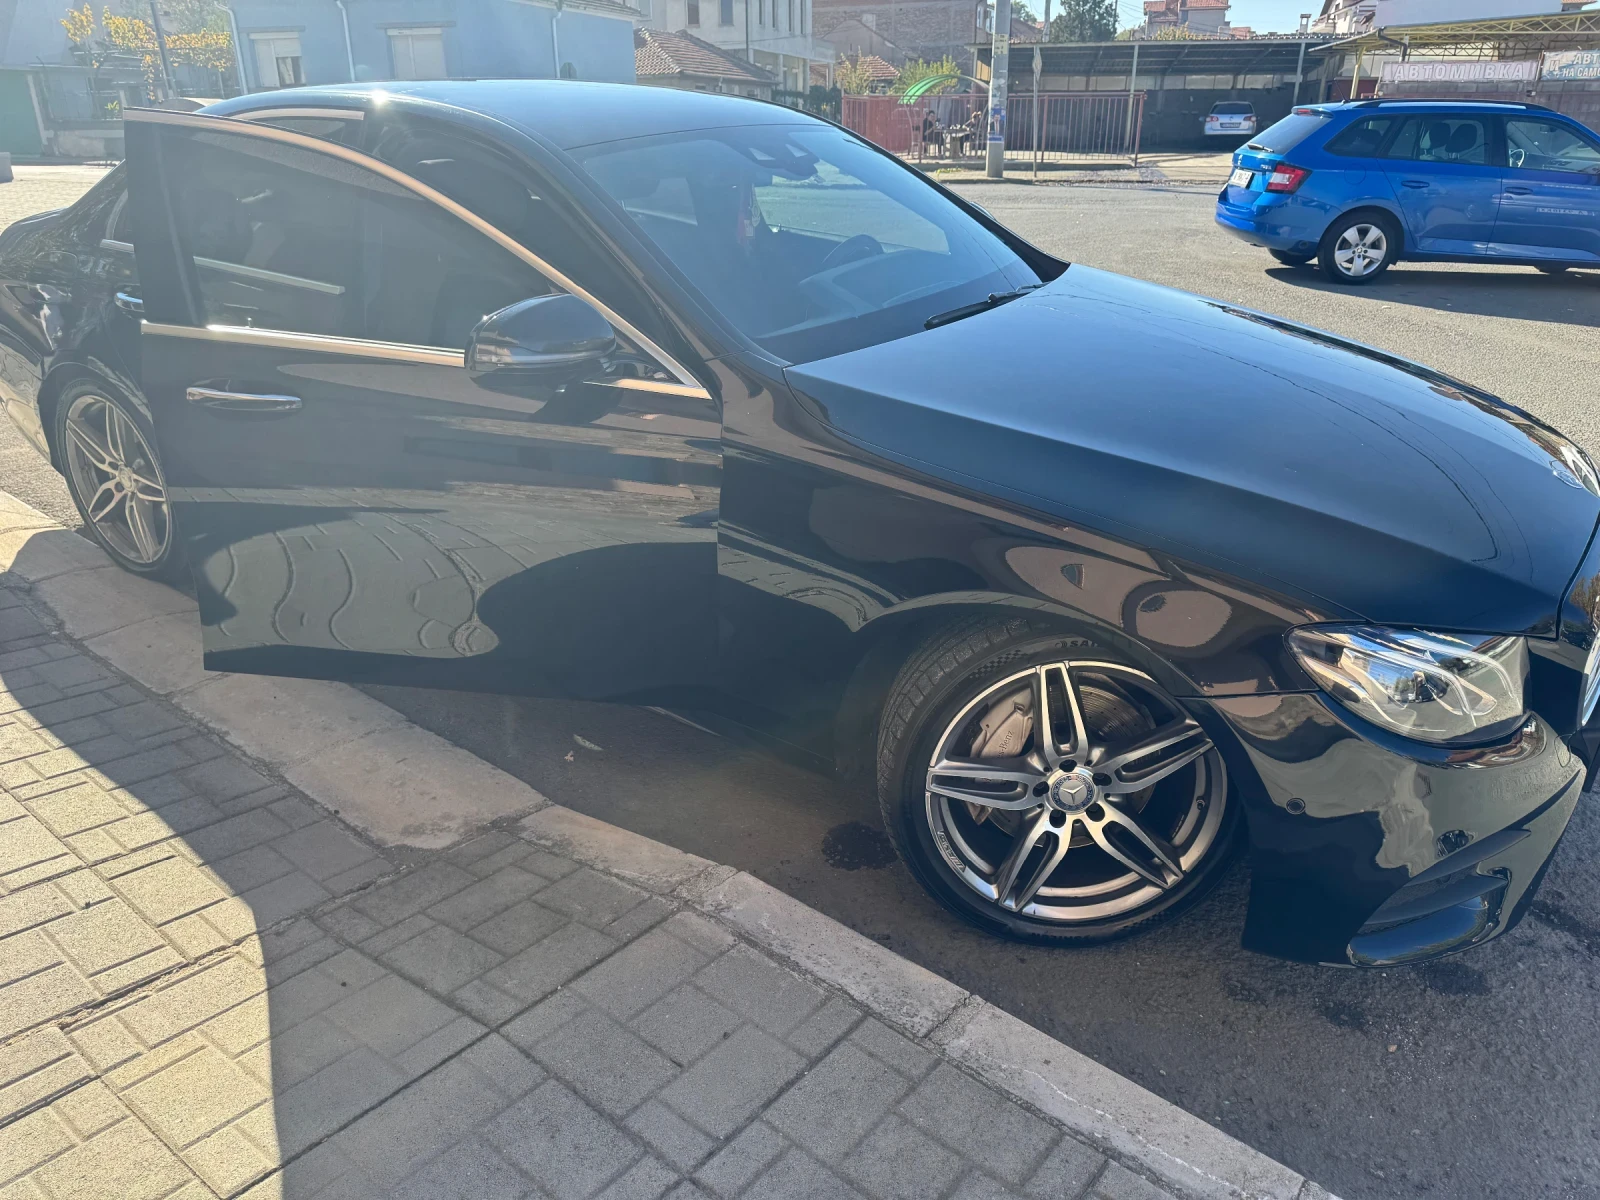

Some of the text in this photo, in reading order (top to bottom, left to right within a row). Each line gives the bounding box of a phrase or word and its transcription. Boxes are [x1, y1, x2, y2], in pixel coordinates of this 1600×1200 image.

[1393, 63, 1524, 80] АВТОМИВКА
[1562, 68, 1574, 77] НА
[996, 730, 1014, 759] s-Benz
